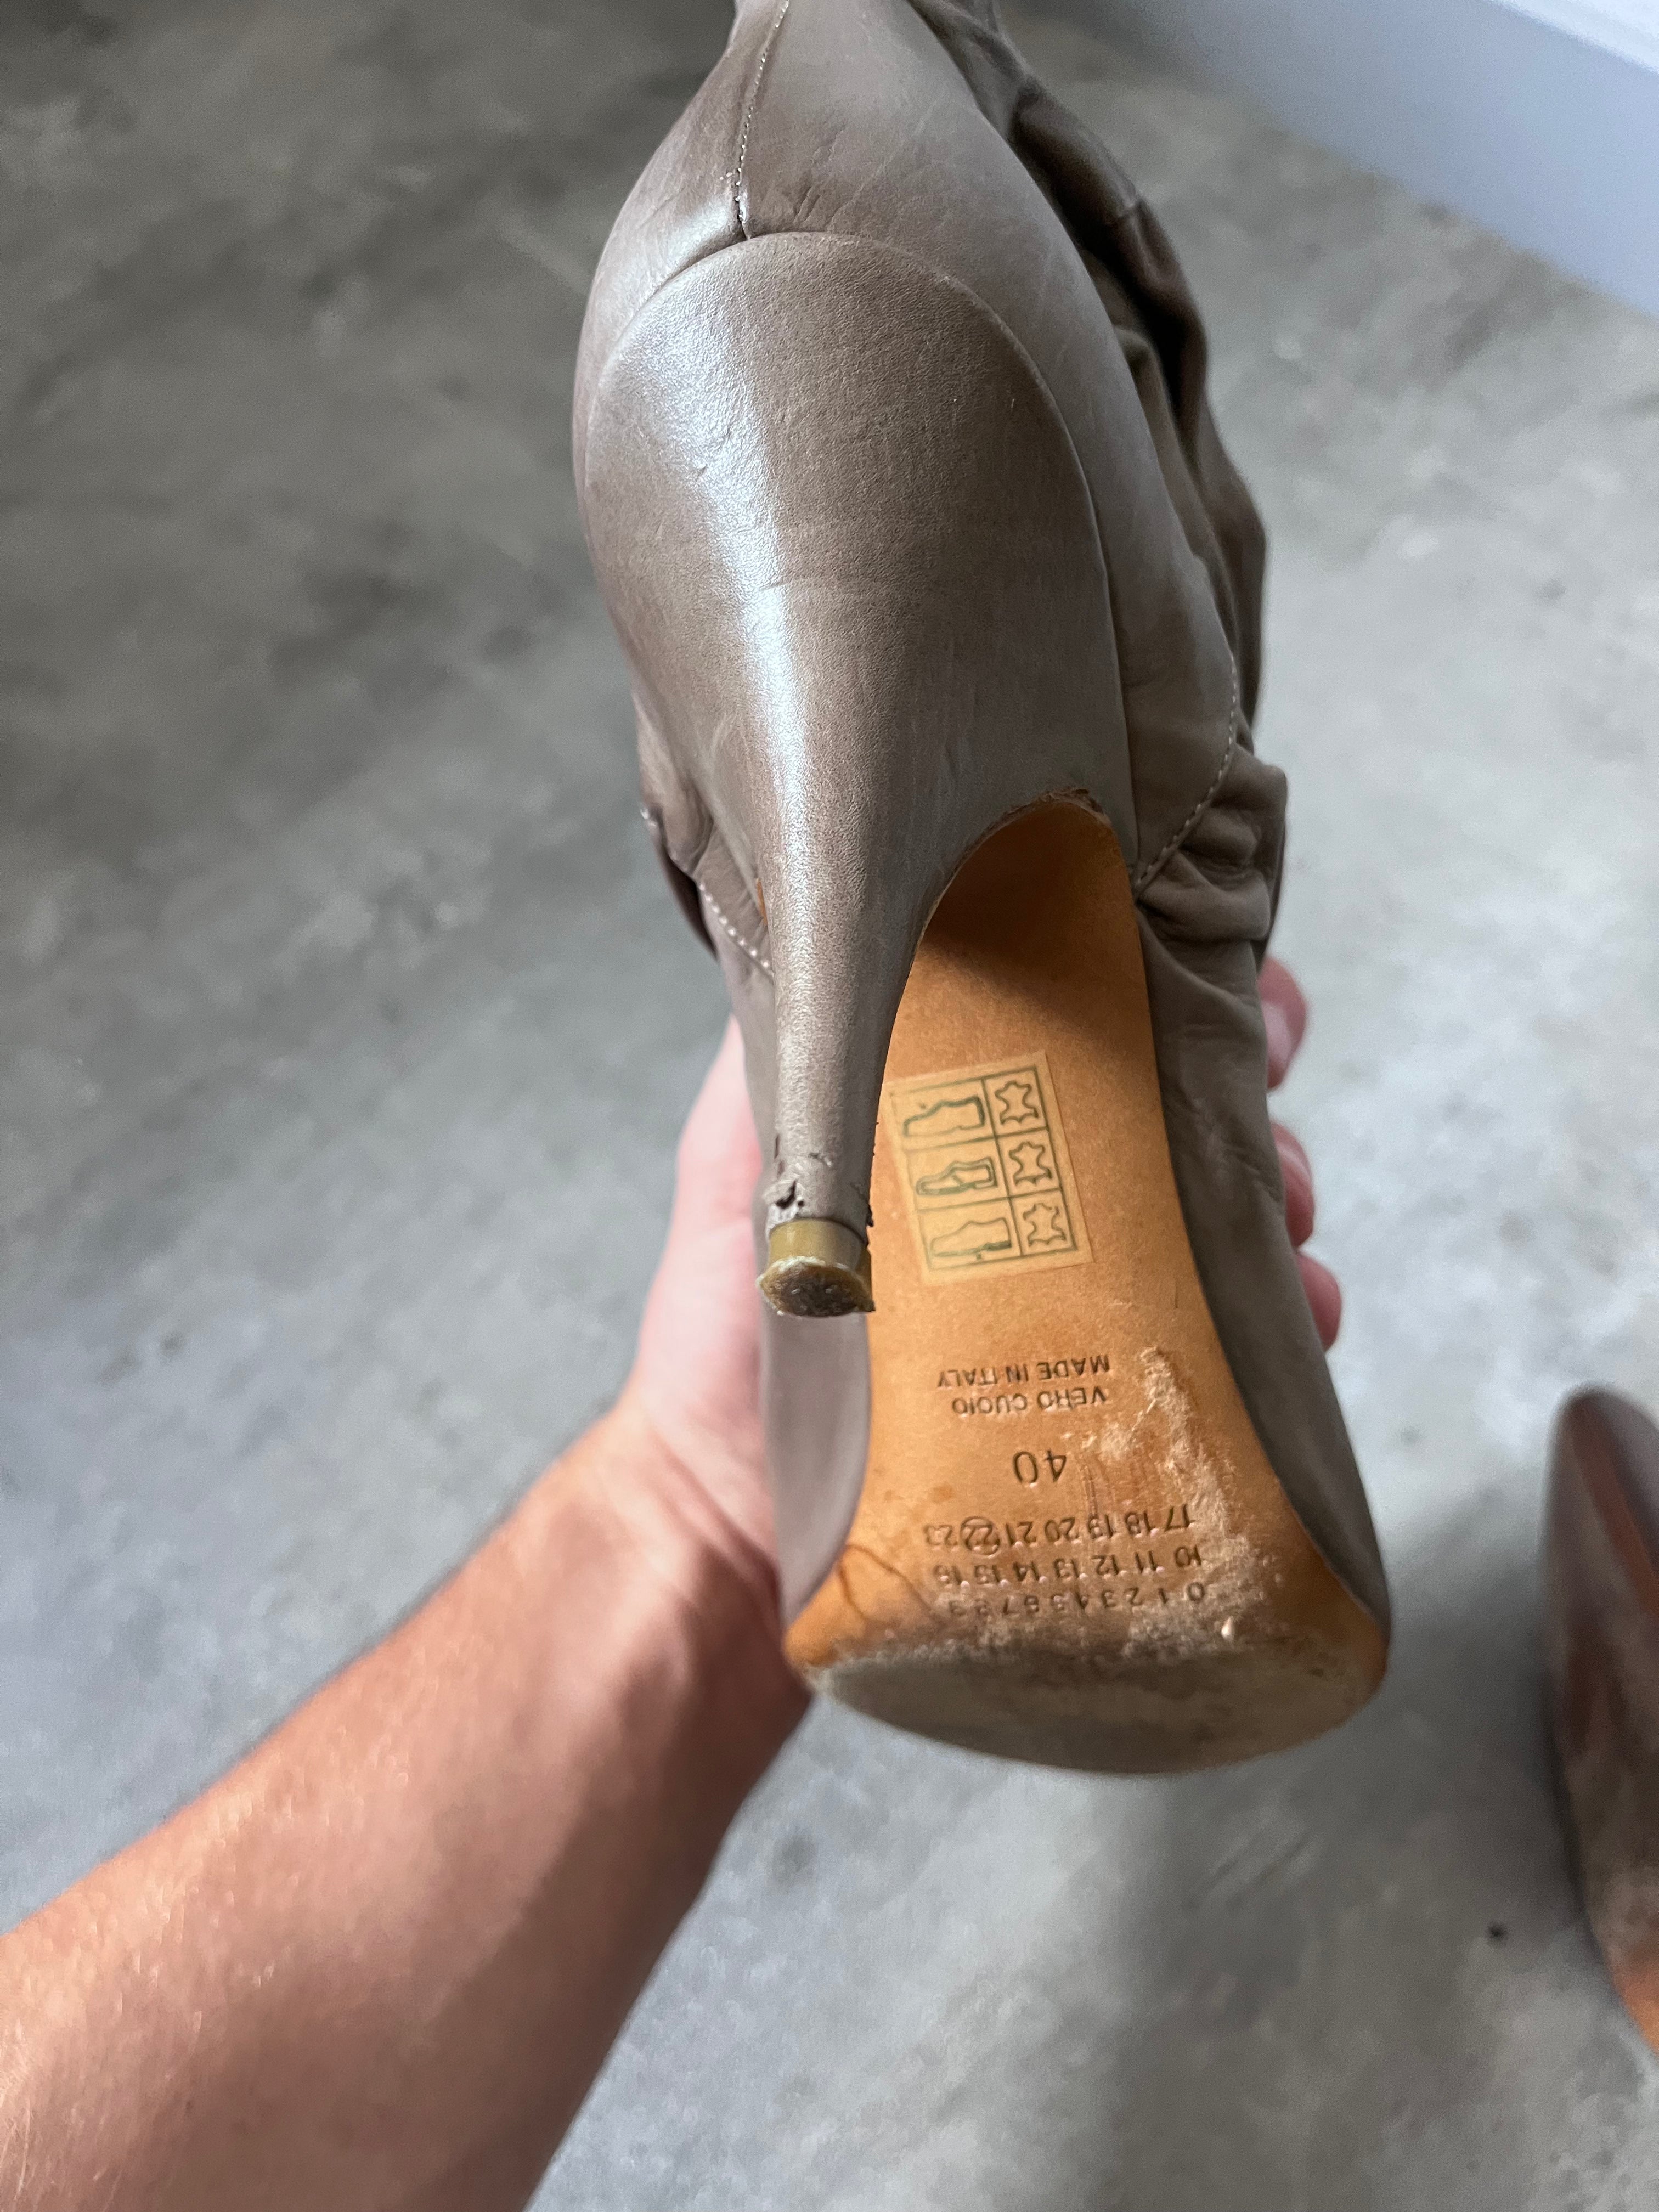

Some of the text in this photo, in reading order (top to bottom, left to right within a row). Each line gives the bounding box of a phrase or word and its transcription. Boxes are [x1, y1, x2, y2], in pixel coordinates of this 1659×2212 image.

[936, 1356, 1110, 1388] MADE IN ITALY
[952, 1387, 1107, 1415] VERO CUOIO
[1012, 1451, 1066, 1485] 40
[924, 1504, 1195, 1548] 17 18 19 20 21 22 23
[1092, 1555, 1120, 1577] 12
[1134, 1551, 1158, 1575] 11
[1175, 1545, 1201, 1568] 10
[974, 1565, 1001, 1585] 15
[1012, 1561, 1041, 1582] 14
[1053, 1558, 1080, 1579] 13
[1124, 1588, 1143, 1606] 2
